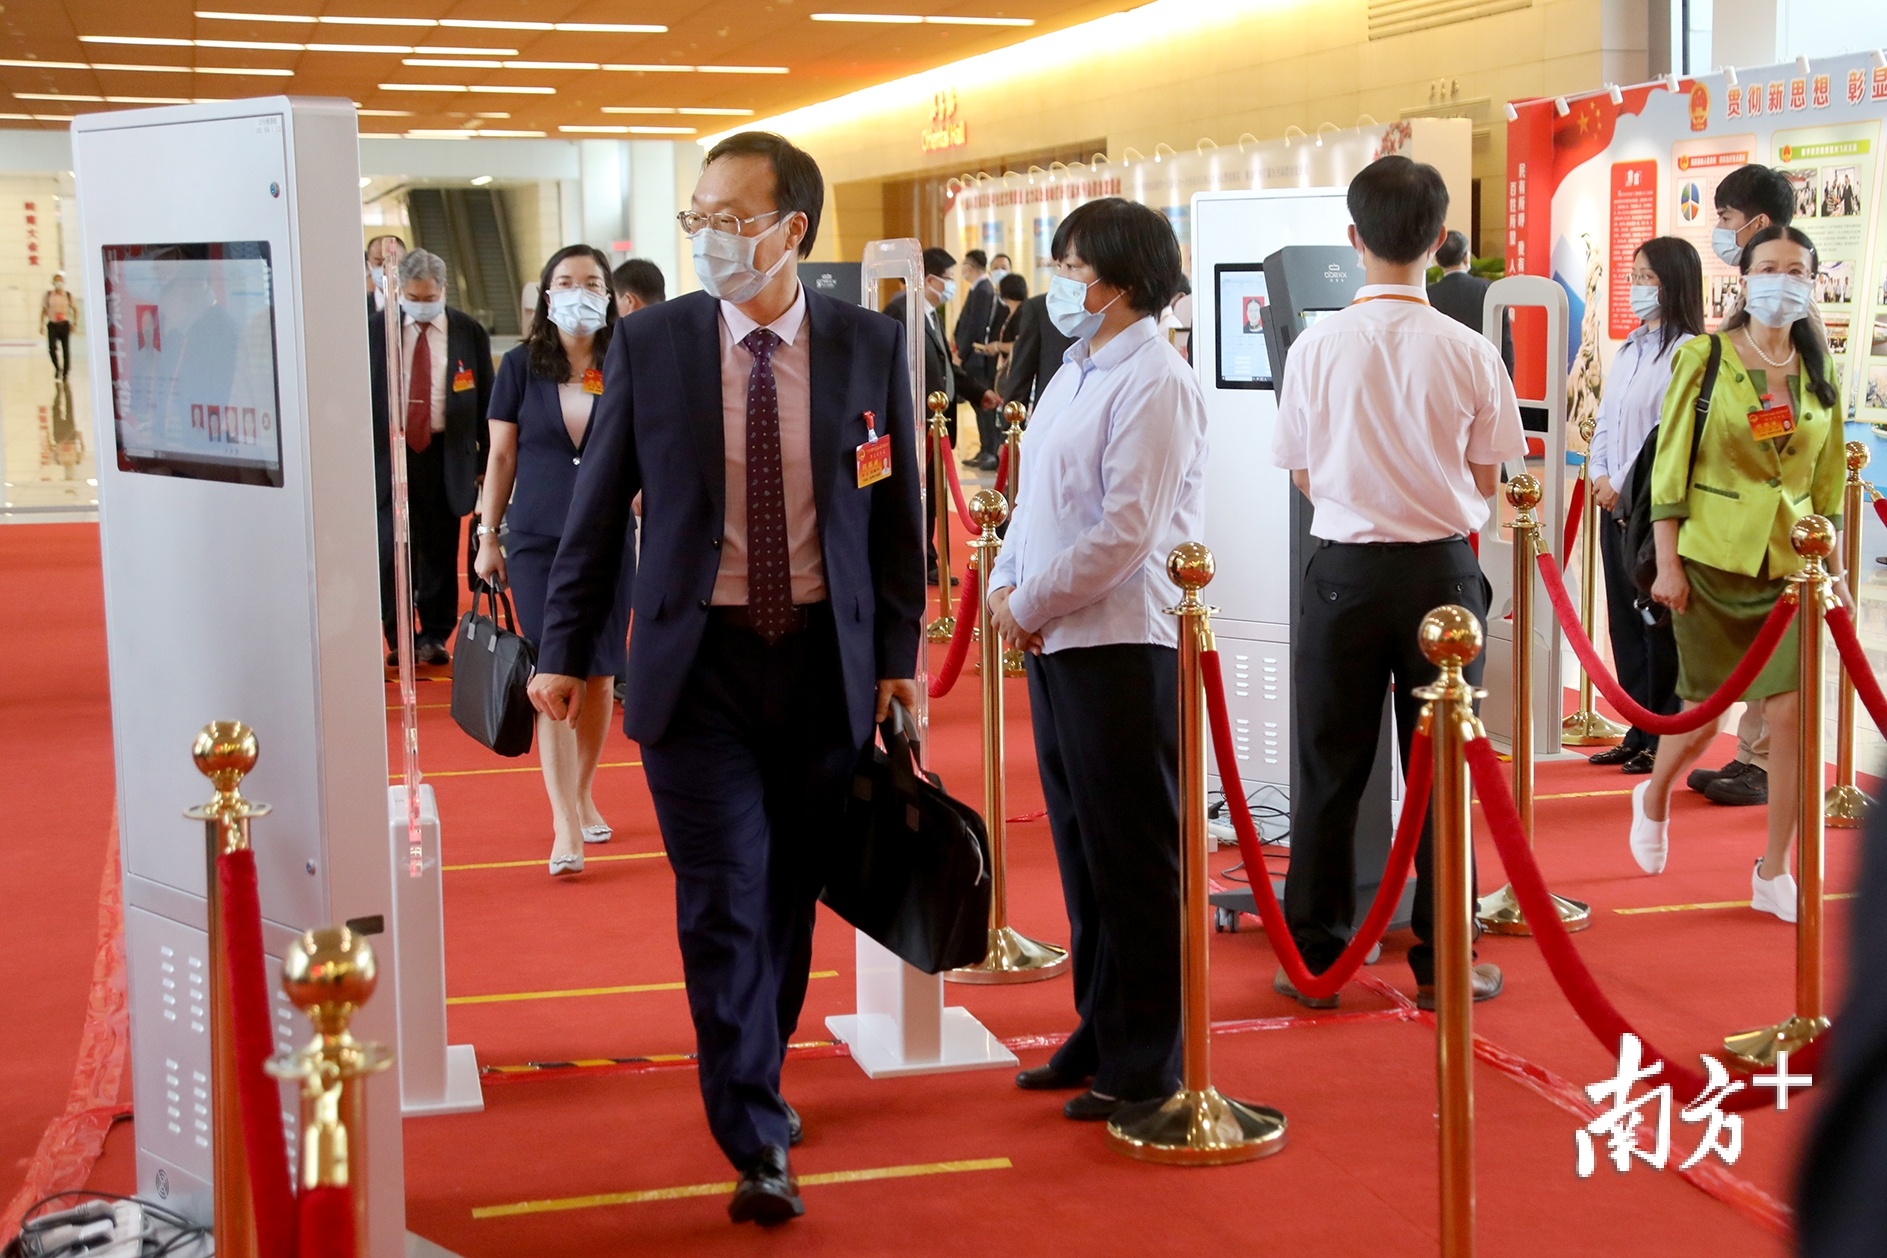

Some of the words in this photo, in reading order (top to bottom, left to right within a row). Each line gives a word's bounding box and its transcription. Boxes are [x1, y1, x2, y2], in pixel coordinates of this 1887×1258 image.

[1727, 73, 1832, 118] 贯彻新思想
[1848, 66, 1887, 104] 彰显
